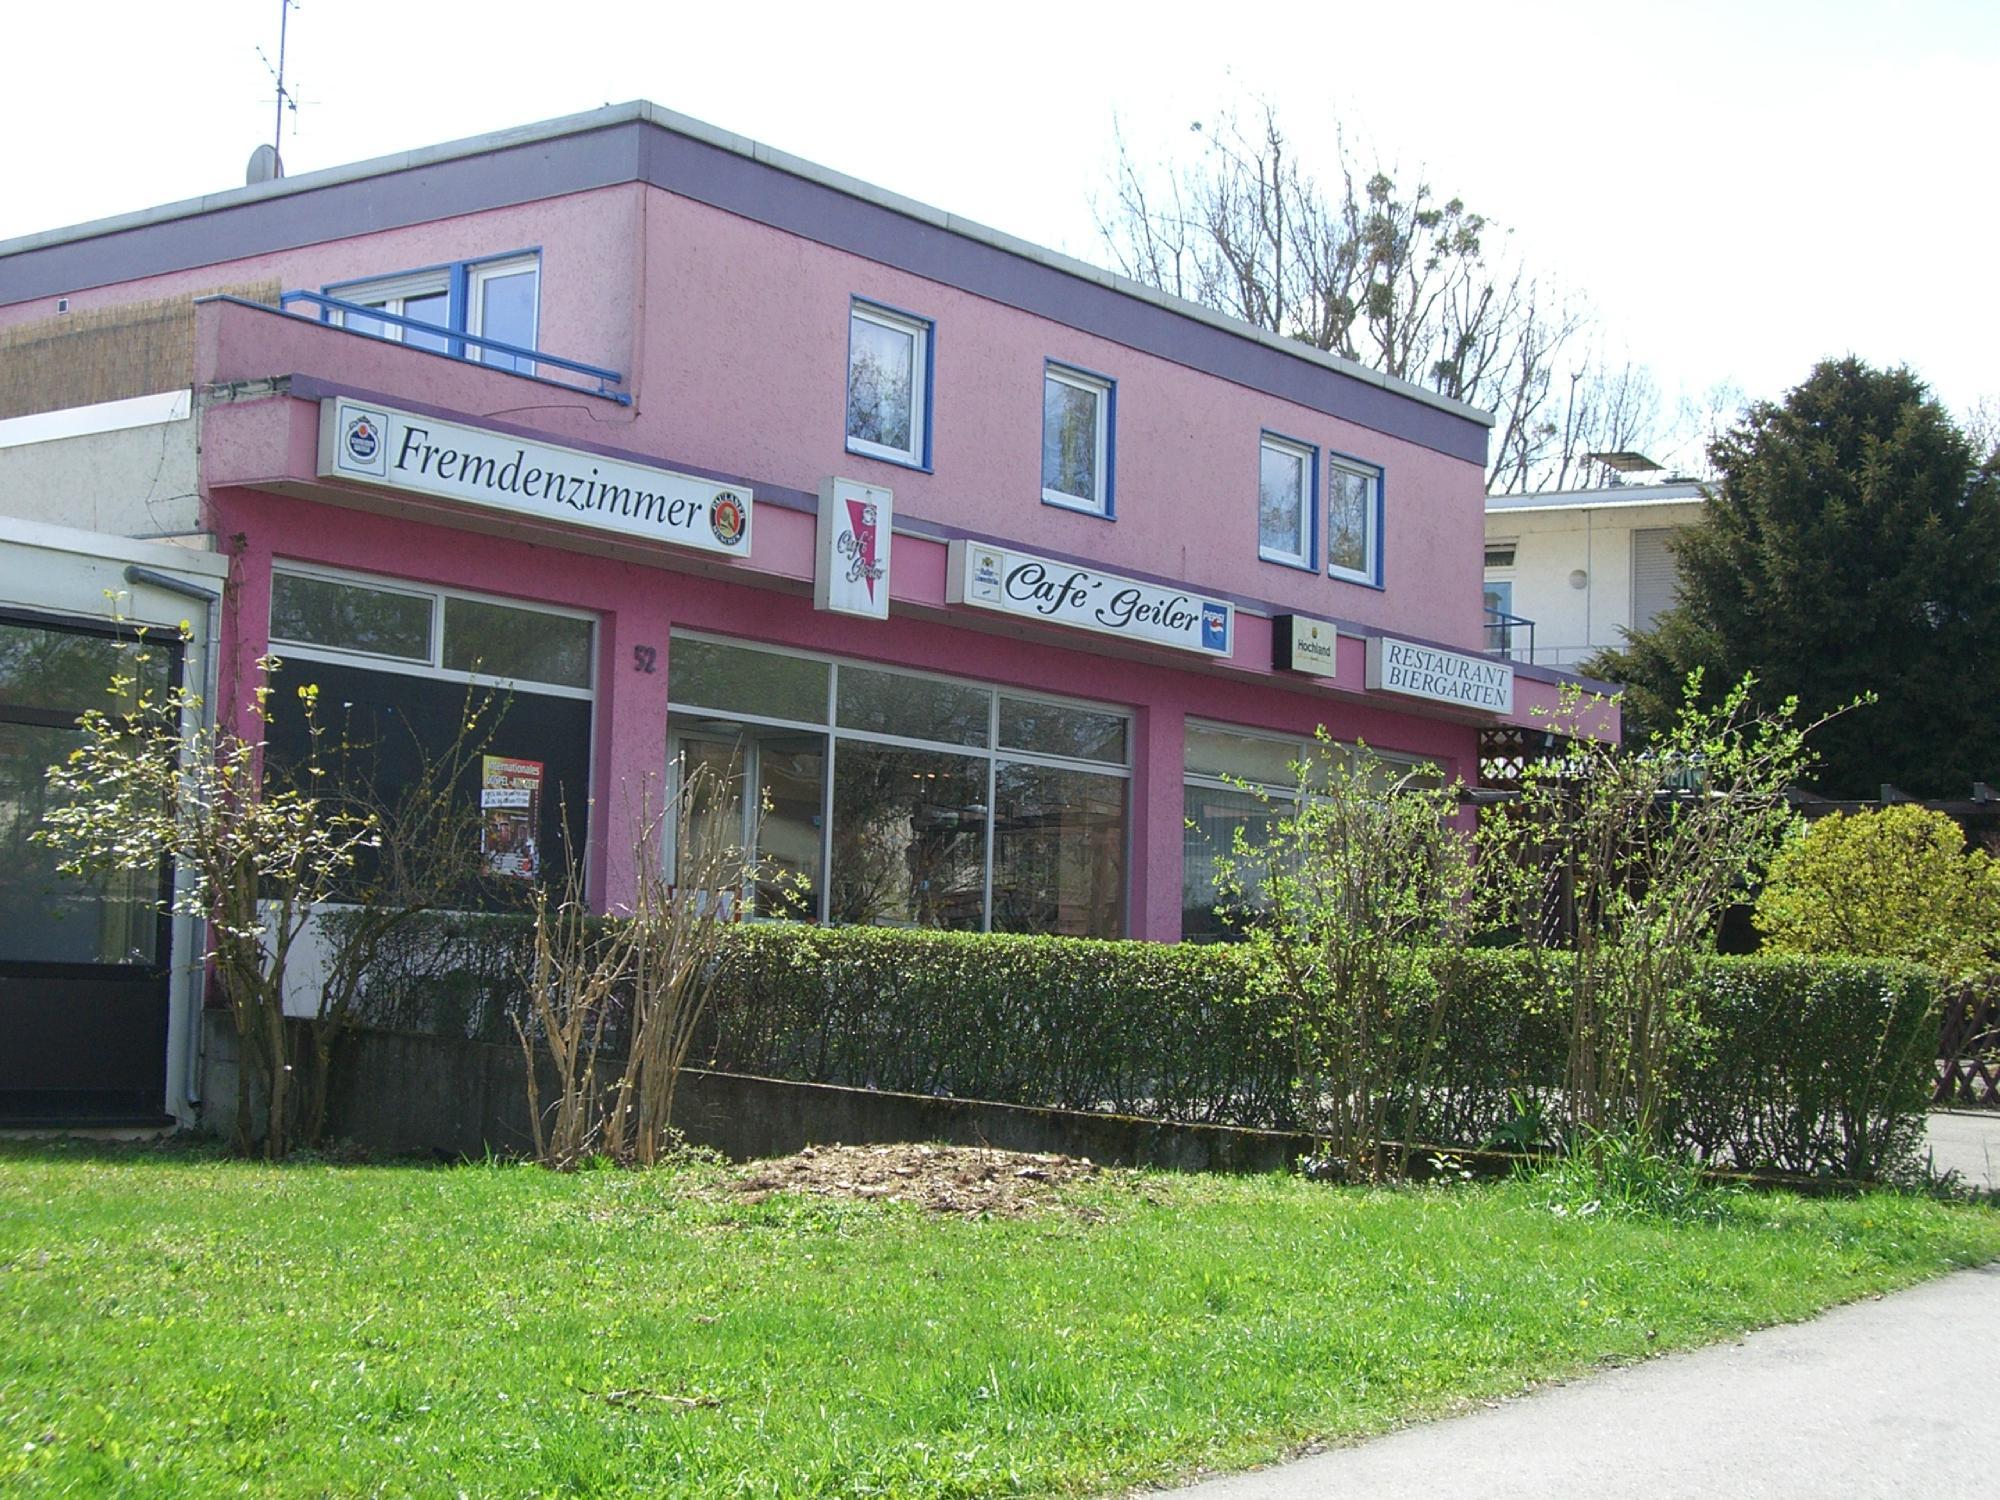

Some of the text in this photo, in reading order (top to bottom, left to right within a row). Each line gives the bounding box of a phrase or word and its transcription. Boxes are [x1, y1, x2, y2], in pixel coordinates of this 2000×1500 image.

[394, 425, 702, 528] Fremdenzimmer
[837, 529, 874, 560] Café
[1005, 563, 1199, 631] Café Geiler
[634, 644, 657, 673] 52
[1297, 639, 1331, 657] Hochland
[1389, 645, 1508, 686] RESTAURANT
[1389, 666, 1507, 706] BIERGARTEN
